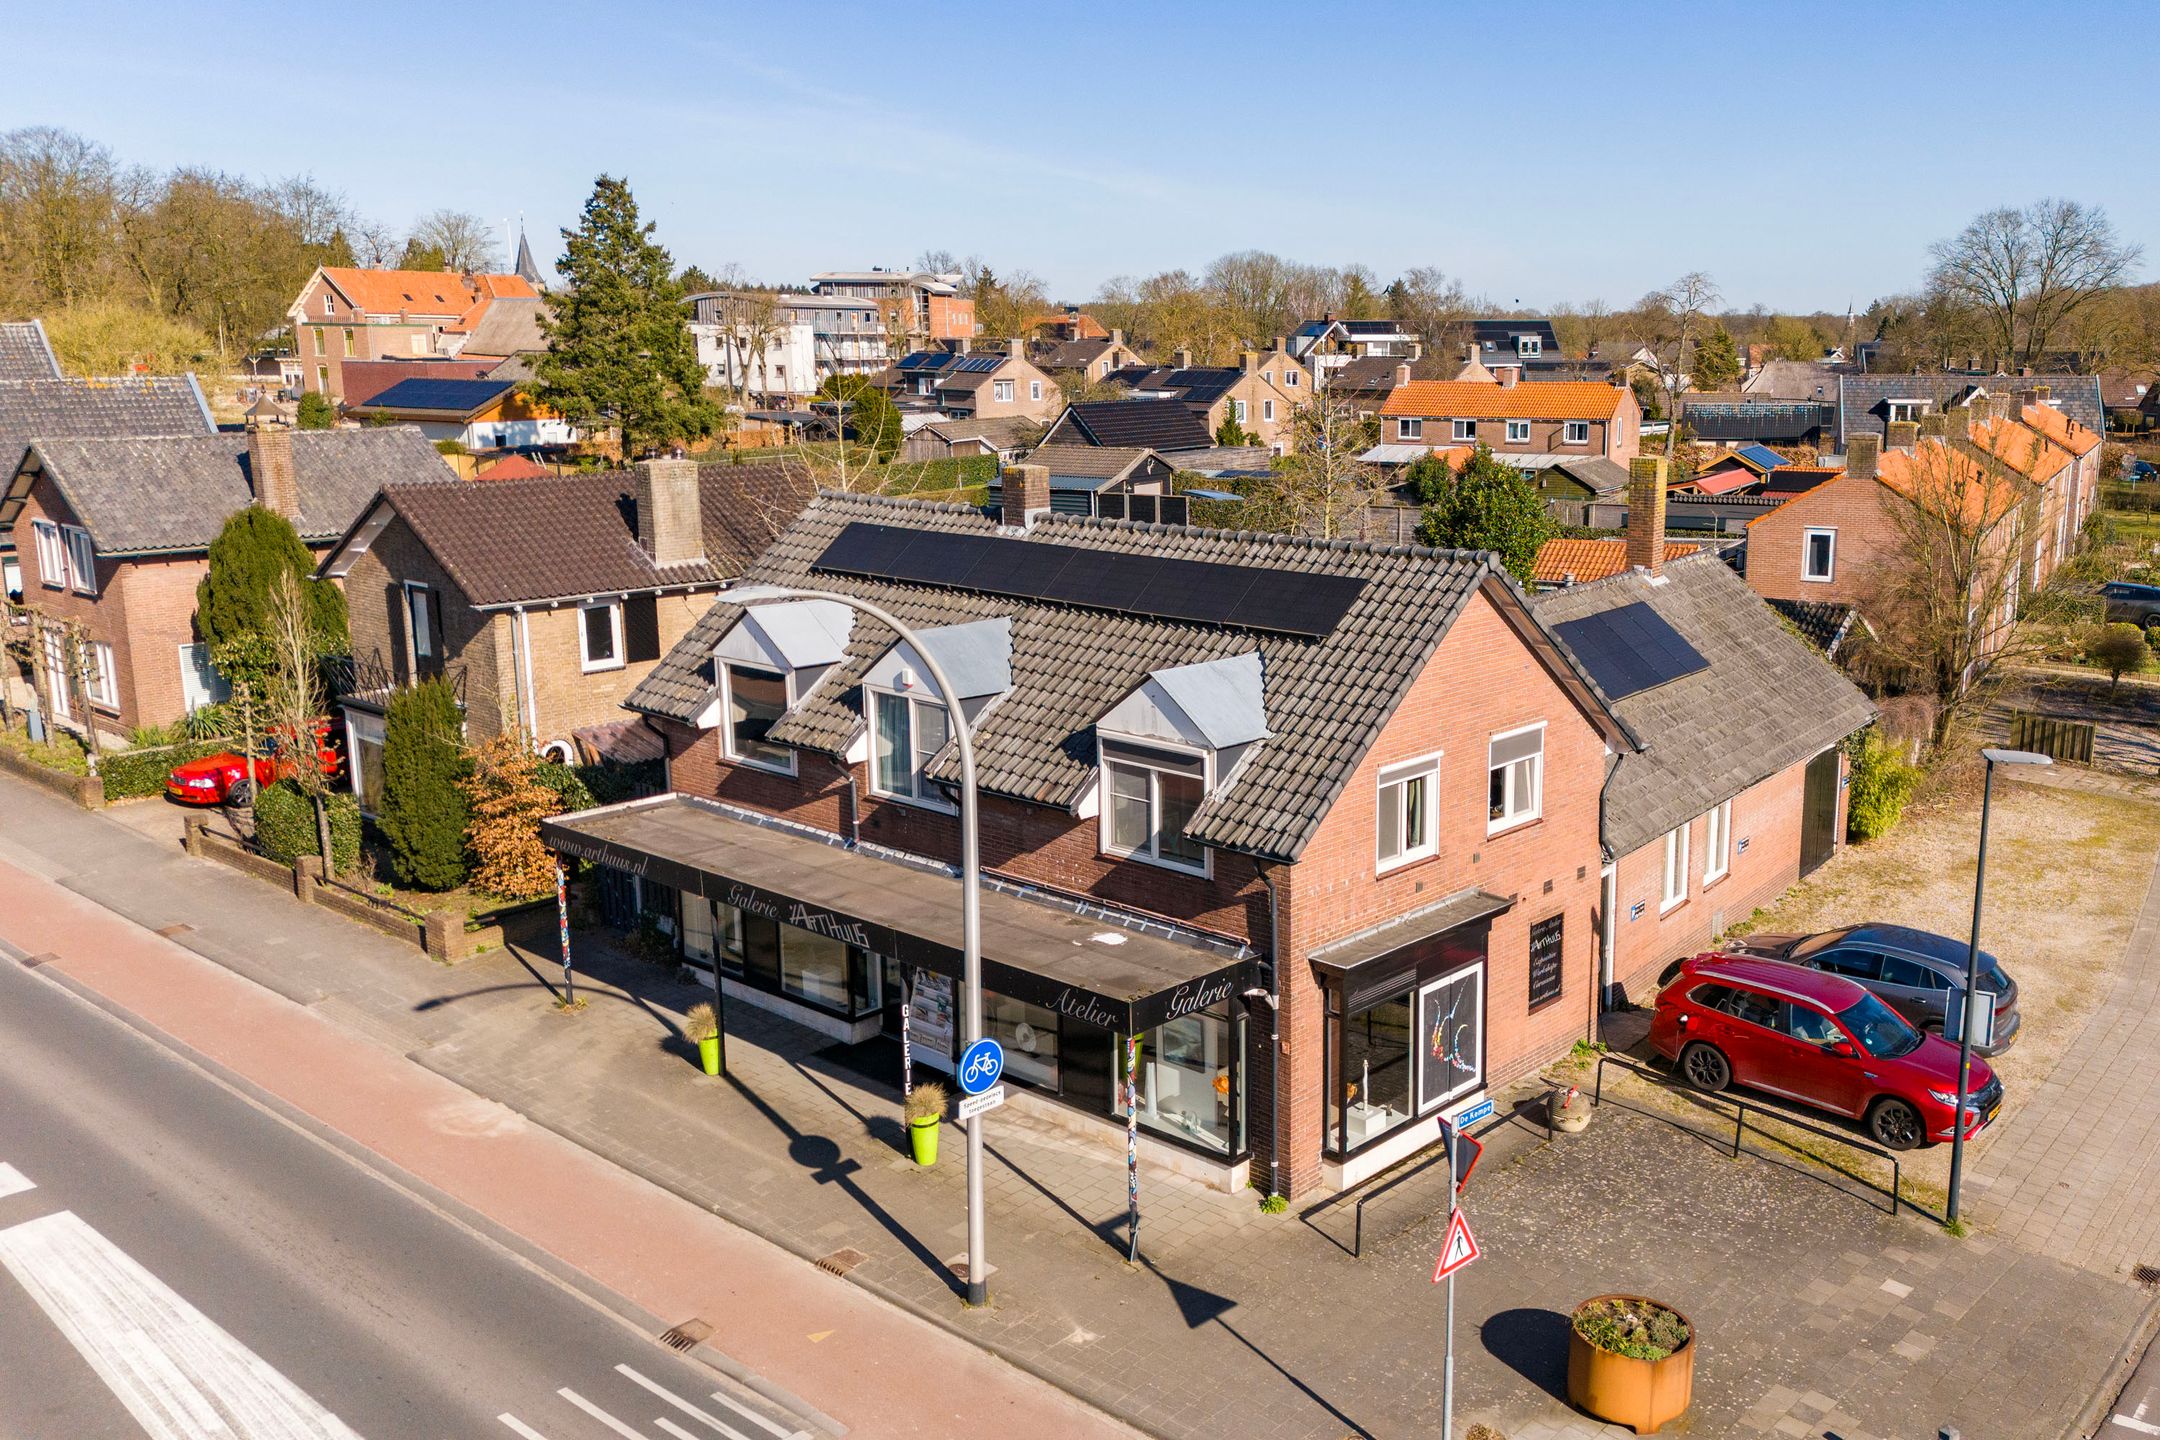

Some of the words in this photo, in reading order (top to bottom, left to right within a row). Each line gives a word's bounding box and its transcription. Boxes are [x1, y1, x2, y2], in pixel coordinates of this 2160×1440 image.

[550, 836, 649, 876] www.arthuus.nl
[728, 884, 779, 918] Galerie
[1046, 988, 1119, 1027] Atelier
[1166, 978, 1234, 1020] Galerie
[902, 1004, 912, 1096] GALERIE
[1460, 1115, 1469, 1125] De
[1469, 1105, 1491, 1120] Kempe
